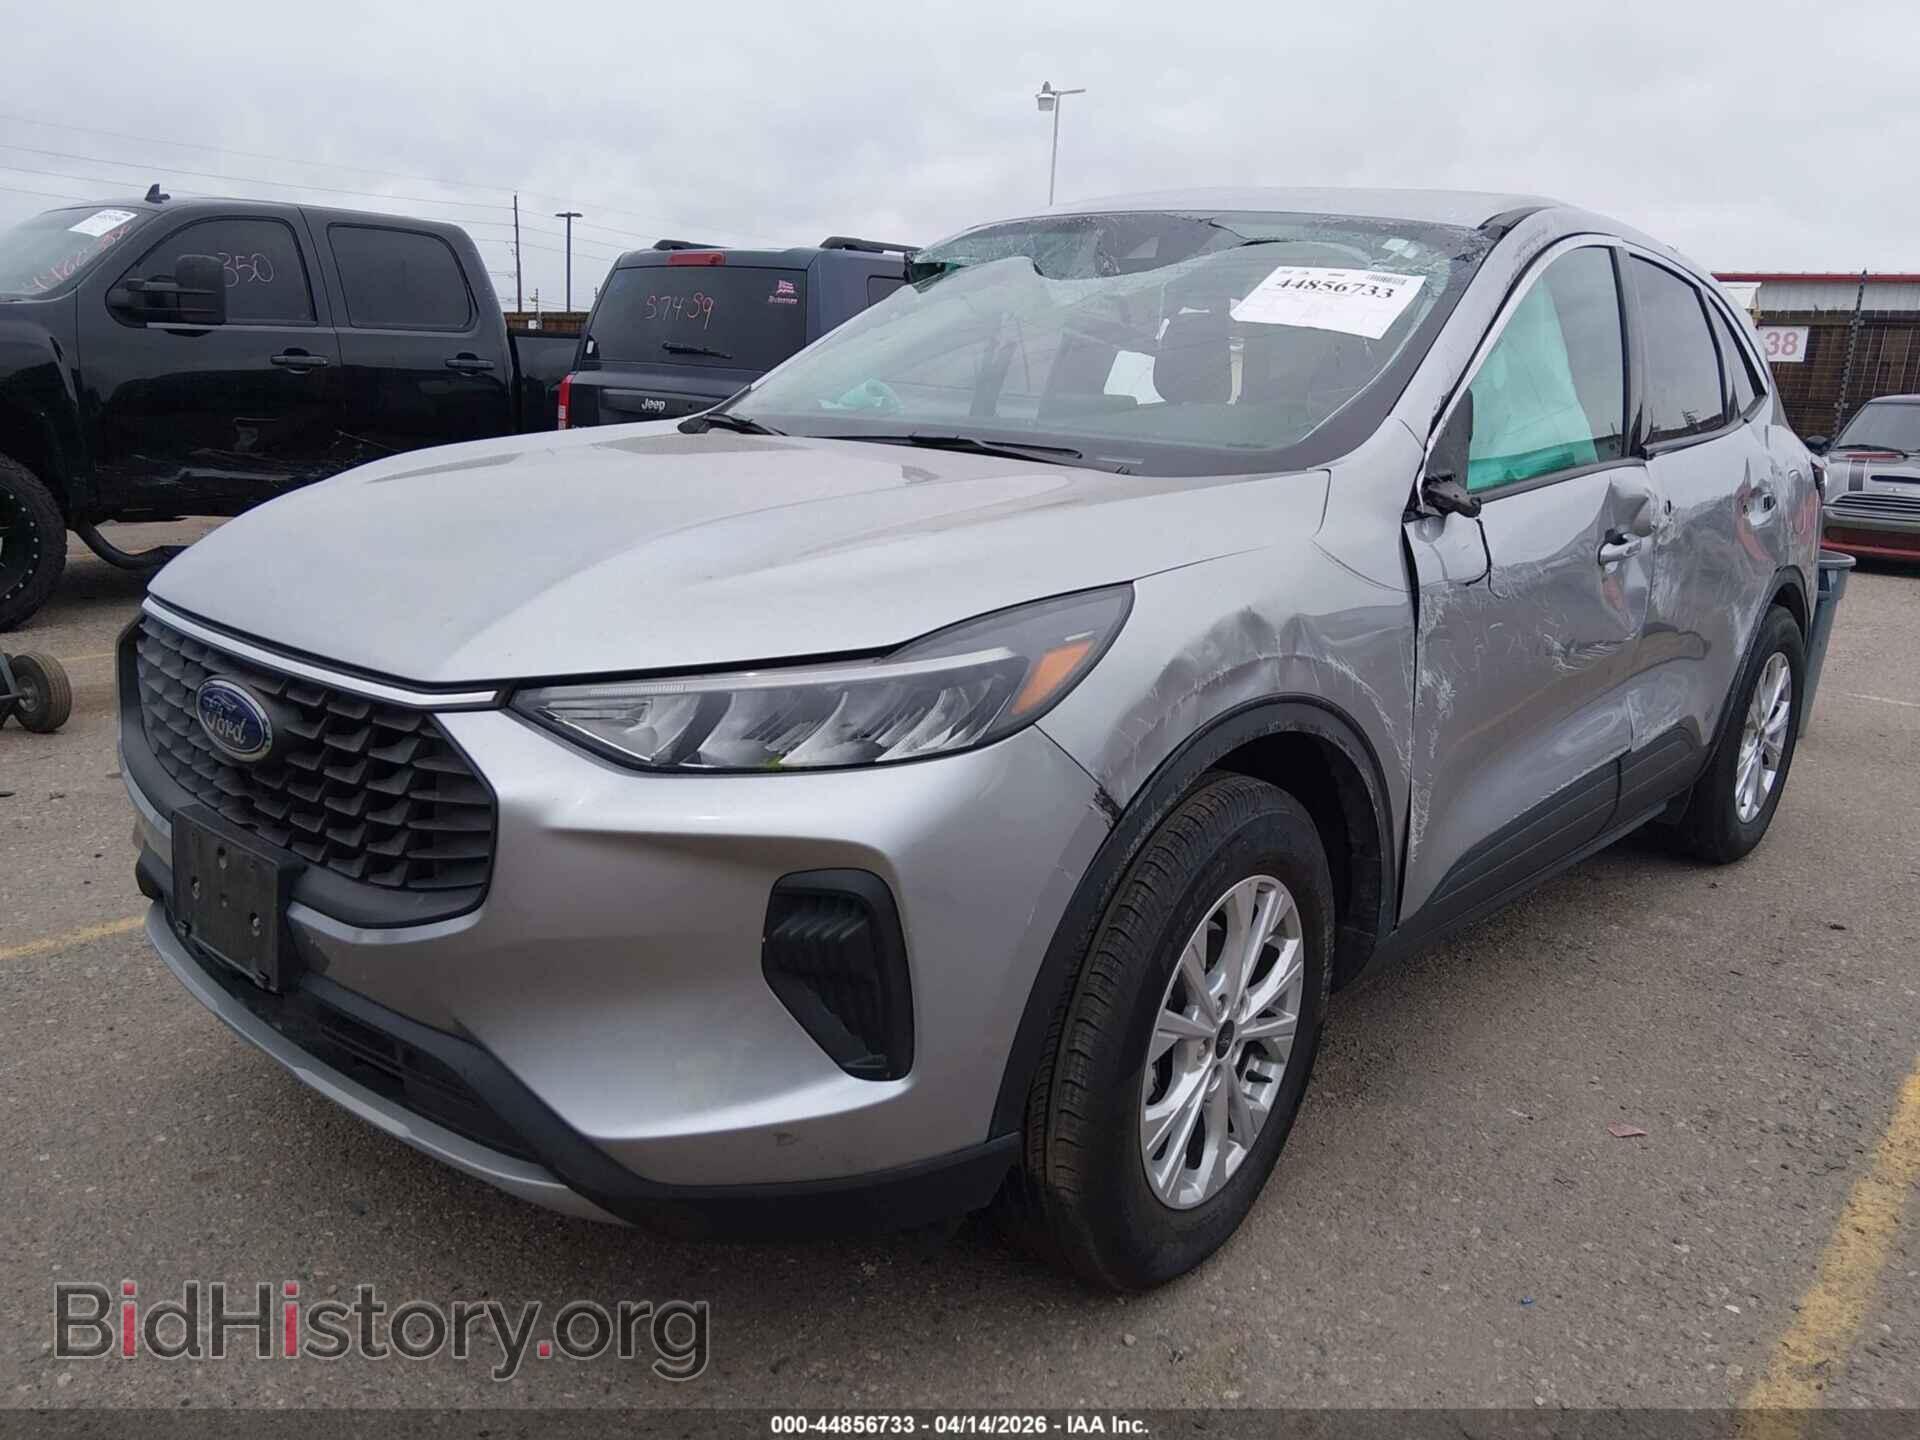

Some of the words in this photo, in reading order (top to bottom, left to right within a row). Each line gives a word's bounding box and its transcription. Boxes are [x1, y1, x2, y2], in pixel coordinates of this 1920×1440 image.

[1276, 278, 1395, 299] 44856733
[1766, 331, 1798, 356] 38
[641, 398, 666, 413] Jeep
[203, 694, 246, 745] Ford
